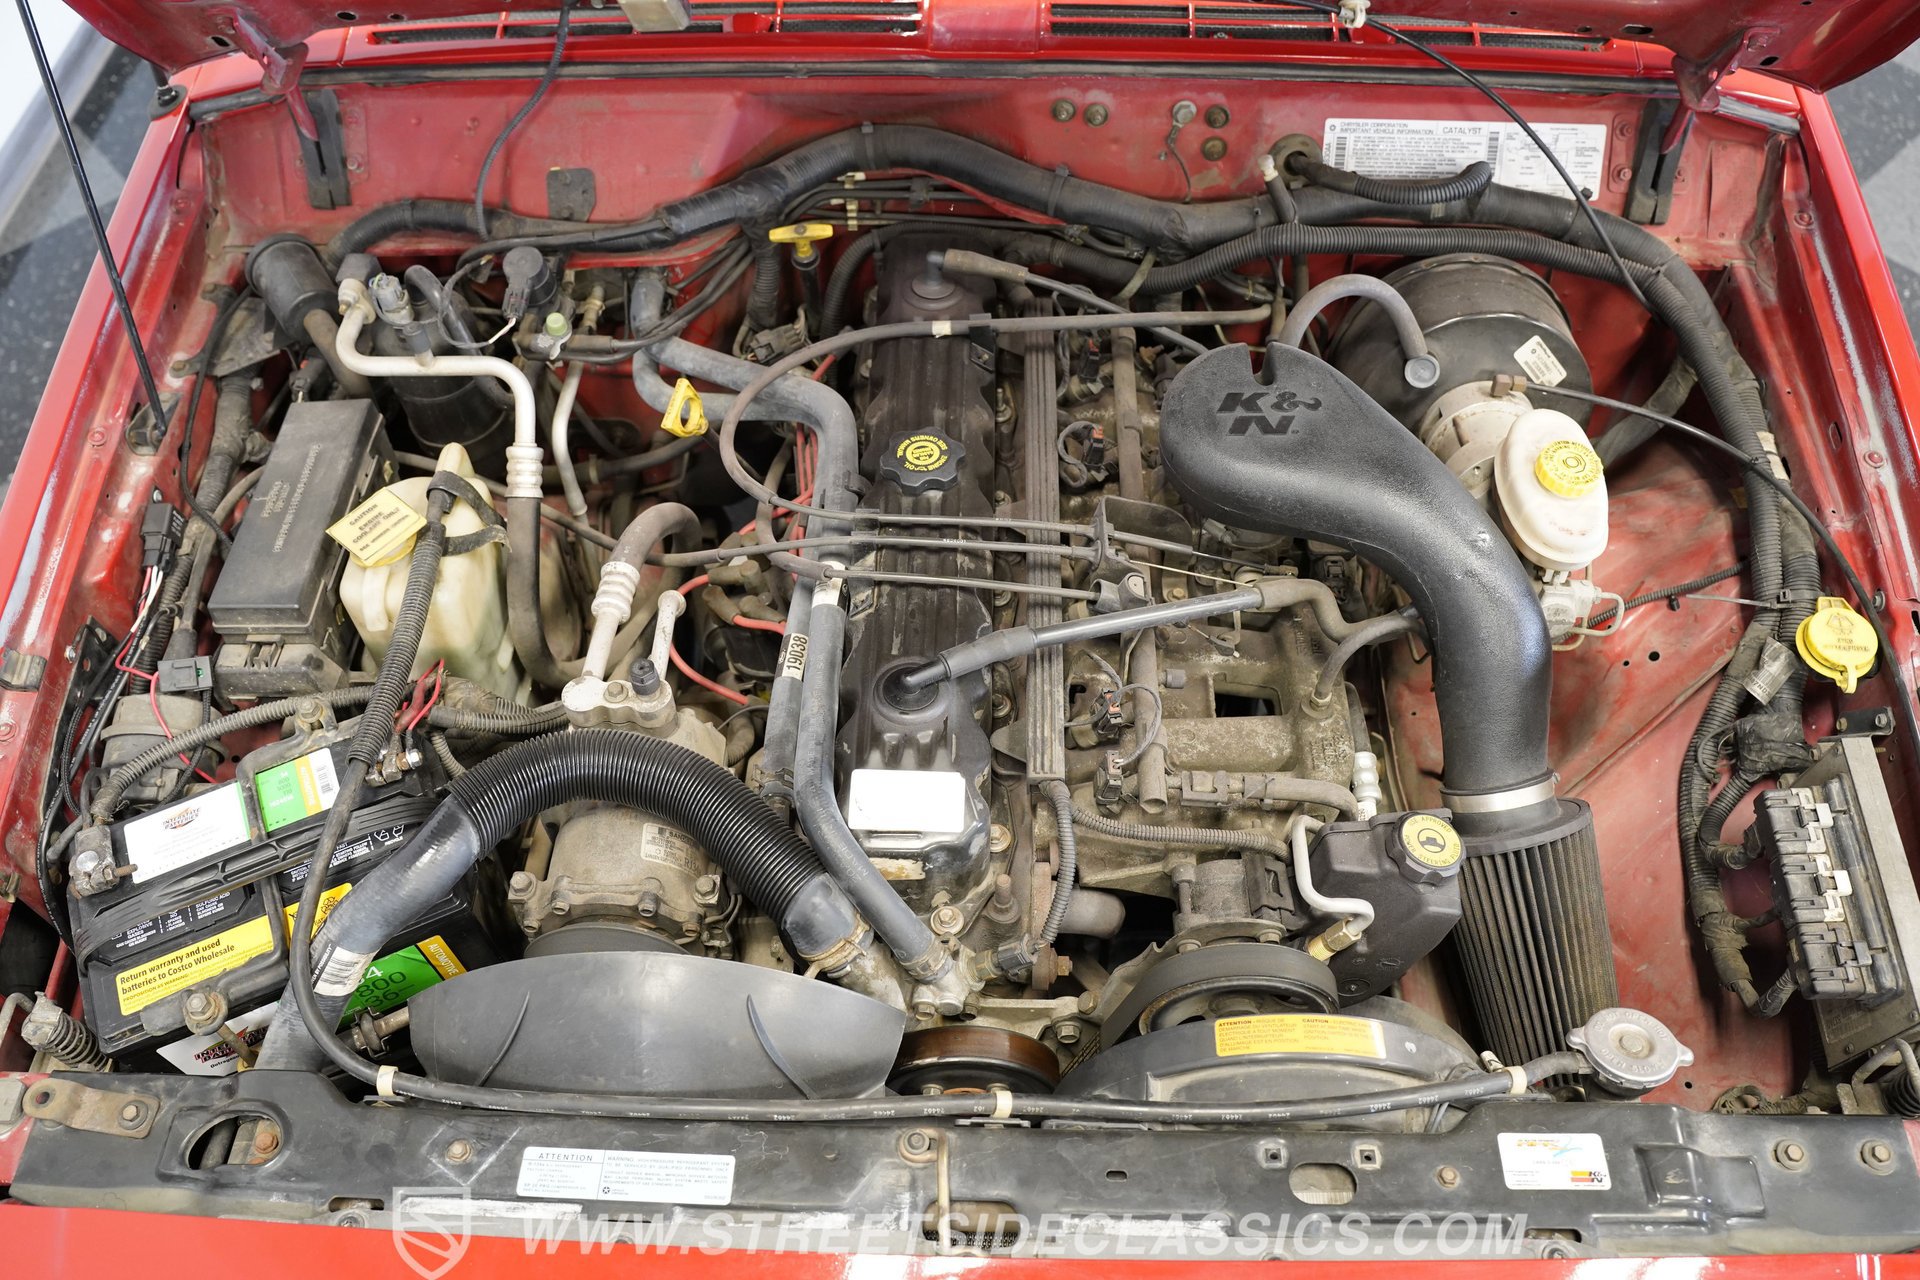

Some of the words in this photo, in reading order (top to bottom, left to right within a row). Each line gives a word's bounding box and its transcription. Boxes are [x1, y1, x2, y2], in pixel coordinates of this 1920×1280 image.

[1442, 126, 1482, 135] CATALYST
[904, 461, 915, 470] OIL
[927, 455, 947, 471] ENGINE
[349, 503, 378, 526] CAUTION
[162, 807, 200, 825] INTERSTATE
[1421, 816, 1452, 833] APPROVED
[1419, 854, 1451, 866] STEERING
[126, 922, 153, 934] EXPLOSIVE
[127, 930, 144, 939] GASES
[120, 969, 148, 985] Return
[148, 954, 184, 974] warranty
[185, 945, 201, 959] and
[202, 938, 221, 953] used
[427, 943, 459, 975] AUTOMOTIVE
[121, 977, 157, 995] batteries
[157, 972, 167, 982] to
[167, 961, 193, 976] Costco
[194, 944, 235, 966] Wholesale
[356, 971, 407, 998] 800
[1418, 1094, 1439, 1105] 24462
[1369, 1102, 1392, 1113] 24462
[538, 1152, 593, 1162] ATTENTION
